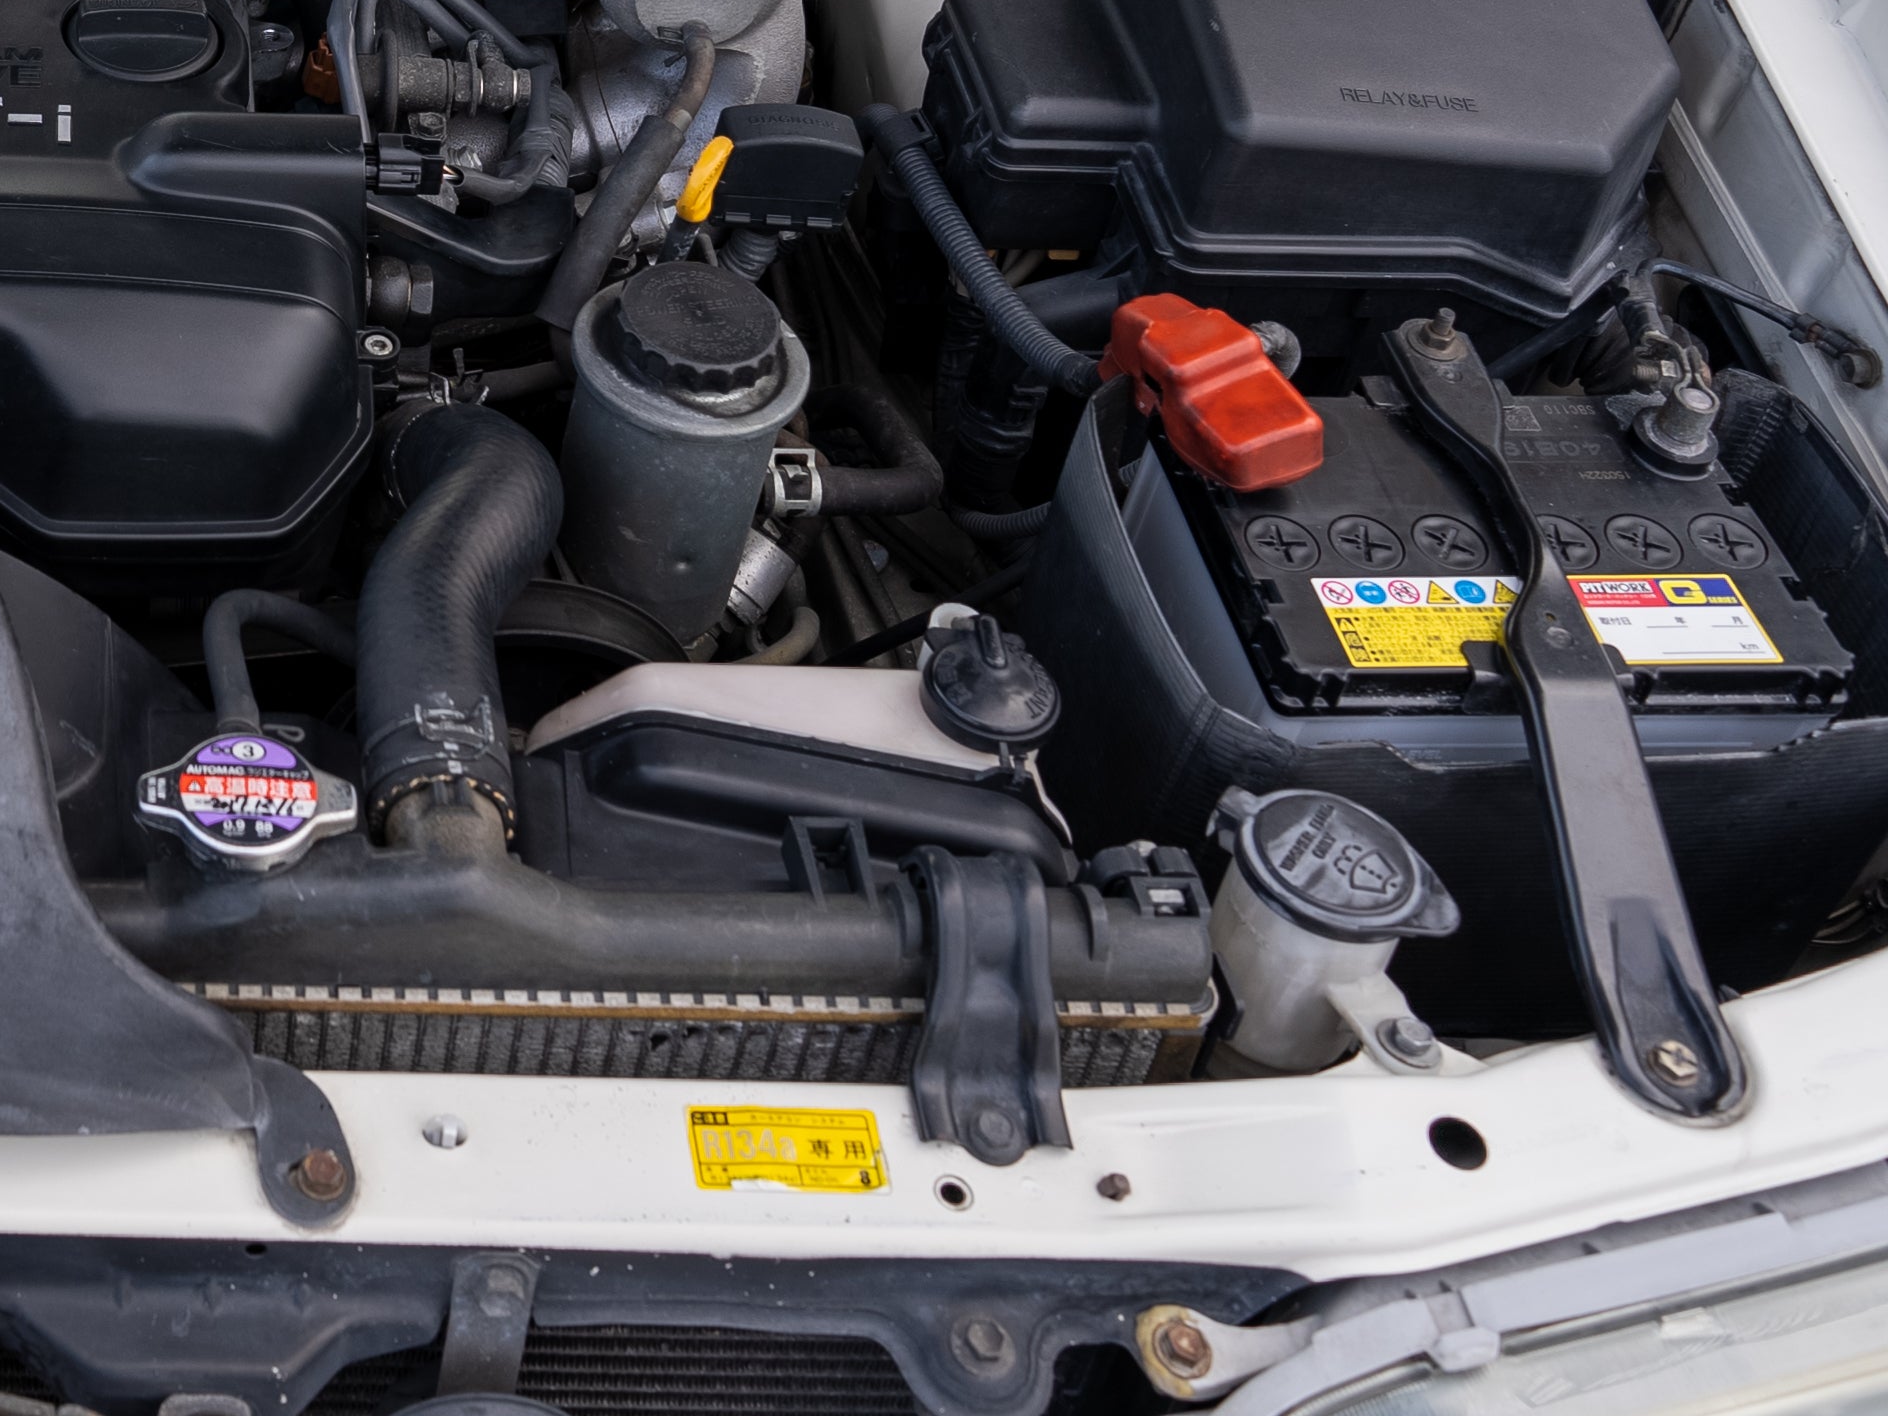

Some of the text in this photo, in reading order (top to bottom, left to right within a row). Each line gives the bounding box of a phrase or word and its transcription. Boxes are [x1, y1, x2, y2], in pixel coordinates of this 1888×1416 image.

[1338, 87, 1480, 113] RELAY&FUSE
[701, 1129, 867, 1162] R134a 専用
[859, 1170, 872, 1186] 8
